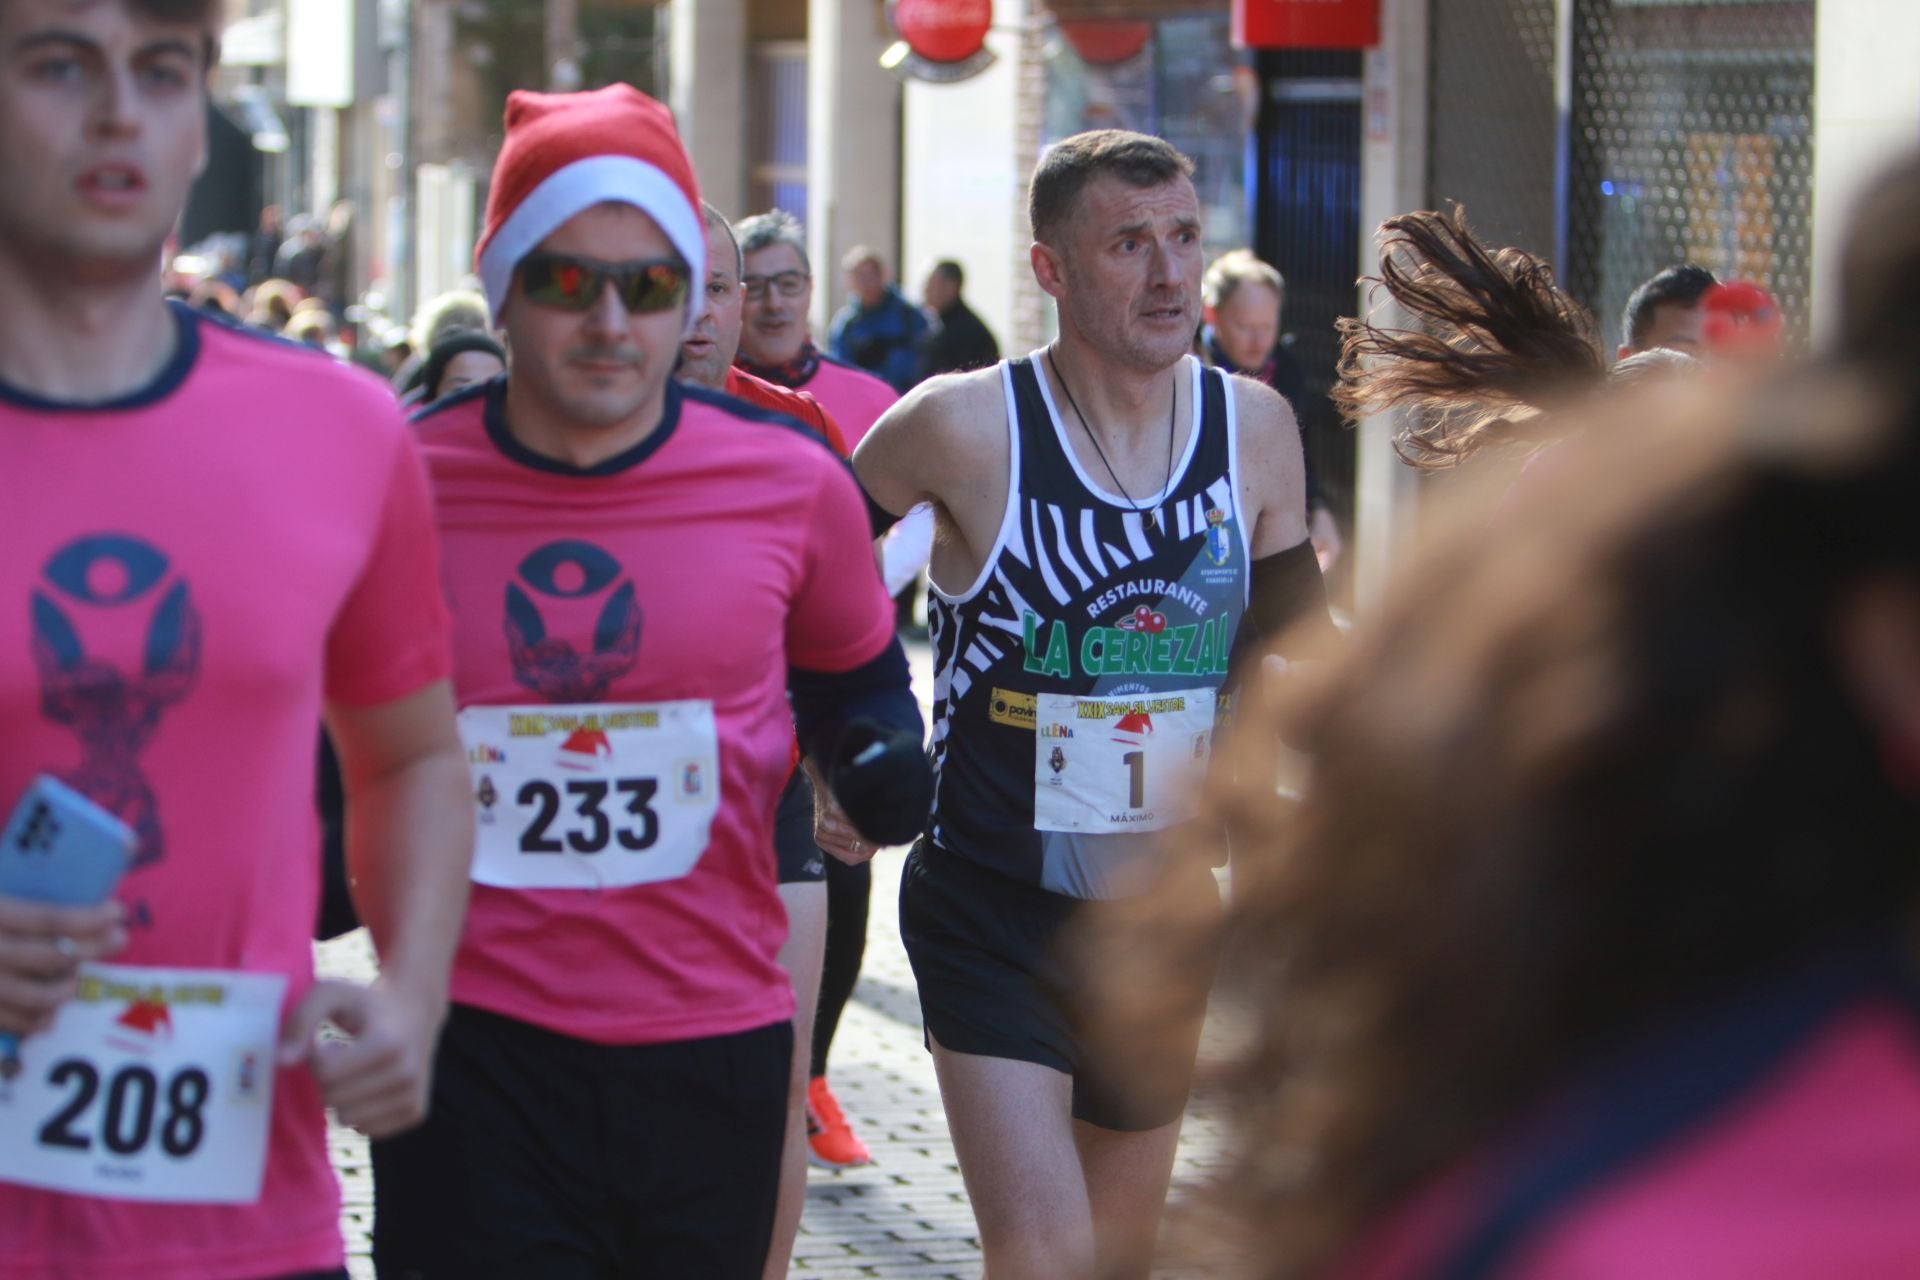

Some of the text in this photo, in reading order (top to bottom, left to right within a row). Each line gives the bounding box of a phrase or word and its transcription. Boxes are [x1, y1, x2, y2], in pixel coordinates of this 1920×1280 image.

[1086, 578, 1208, 619] RESTAURANTE
[1022, 609, 1071, 679] LA
[1077, 697, 1185, 719] XXIX SAN SILVESTRE
[1123, 751, 1144, 809] 1
[516, 777, 659, 854] 233
[37, 1056, 210, 1158] 208
